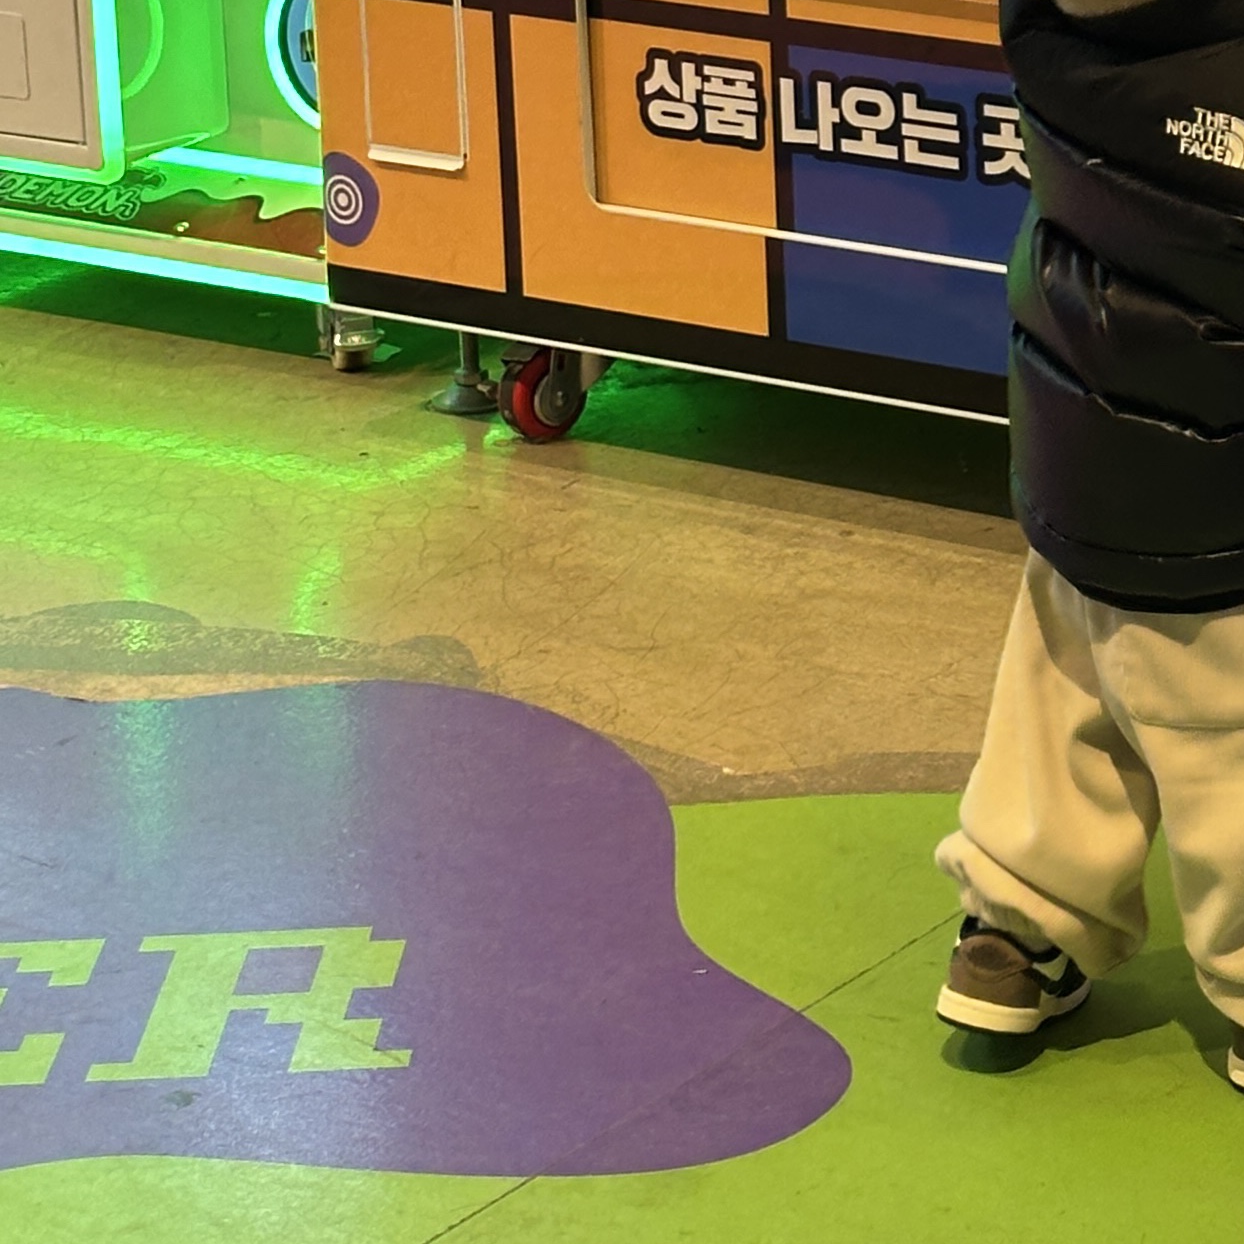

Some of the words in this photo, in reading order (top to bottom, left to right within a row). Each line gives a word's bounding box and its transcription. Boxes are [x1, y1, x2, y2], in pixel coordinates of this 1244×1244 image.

[644, 58, 759, 140] 상품
[779, 76, 961, 172] 나오는
[1193, 106, 1231, 130] THE
[1166, 117, 1229, 147] NORTH
[1180, 137, 1224, 163] FACE
